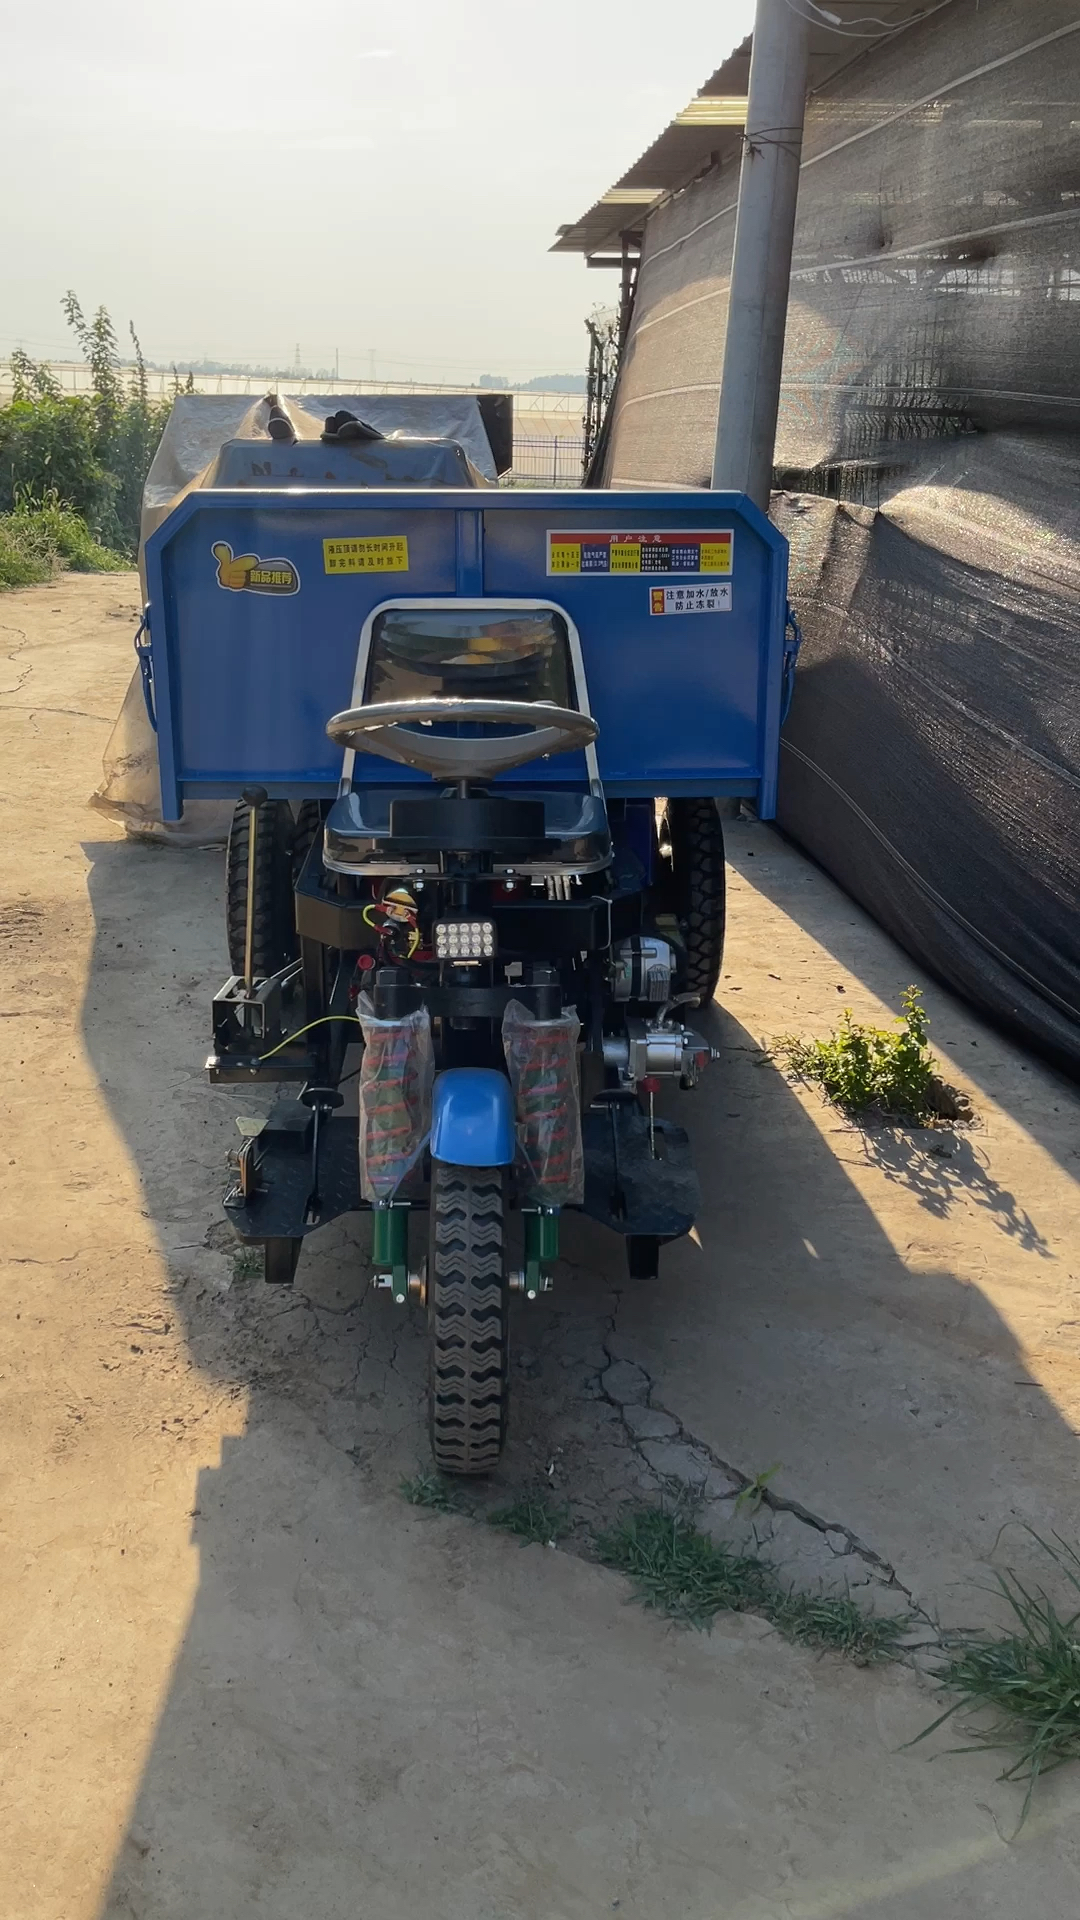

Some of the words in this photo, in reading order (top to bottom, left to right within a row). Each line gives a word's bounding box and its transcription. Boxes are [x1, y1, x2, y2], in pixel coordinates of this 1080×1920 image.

[249, 570, 293, 585] 新品推荐
[666, 587, 729, 601] 注意加水/放水
